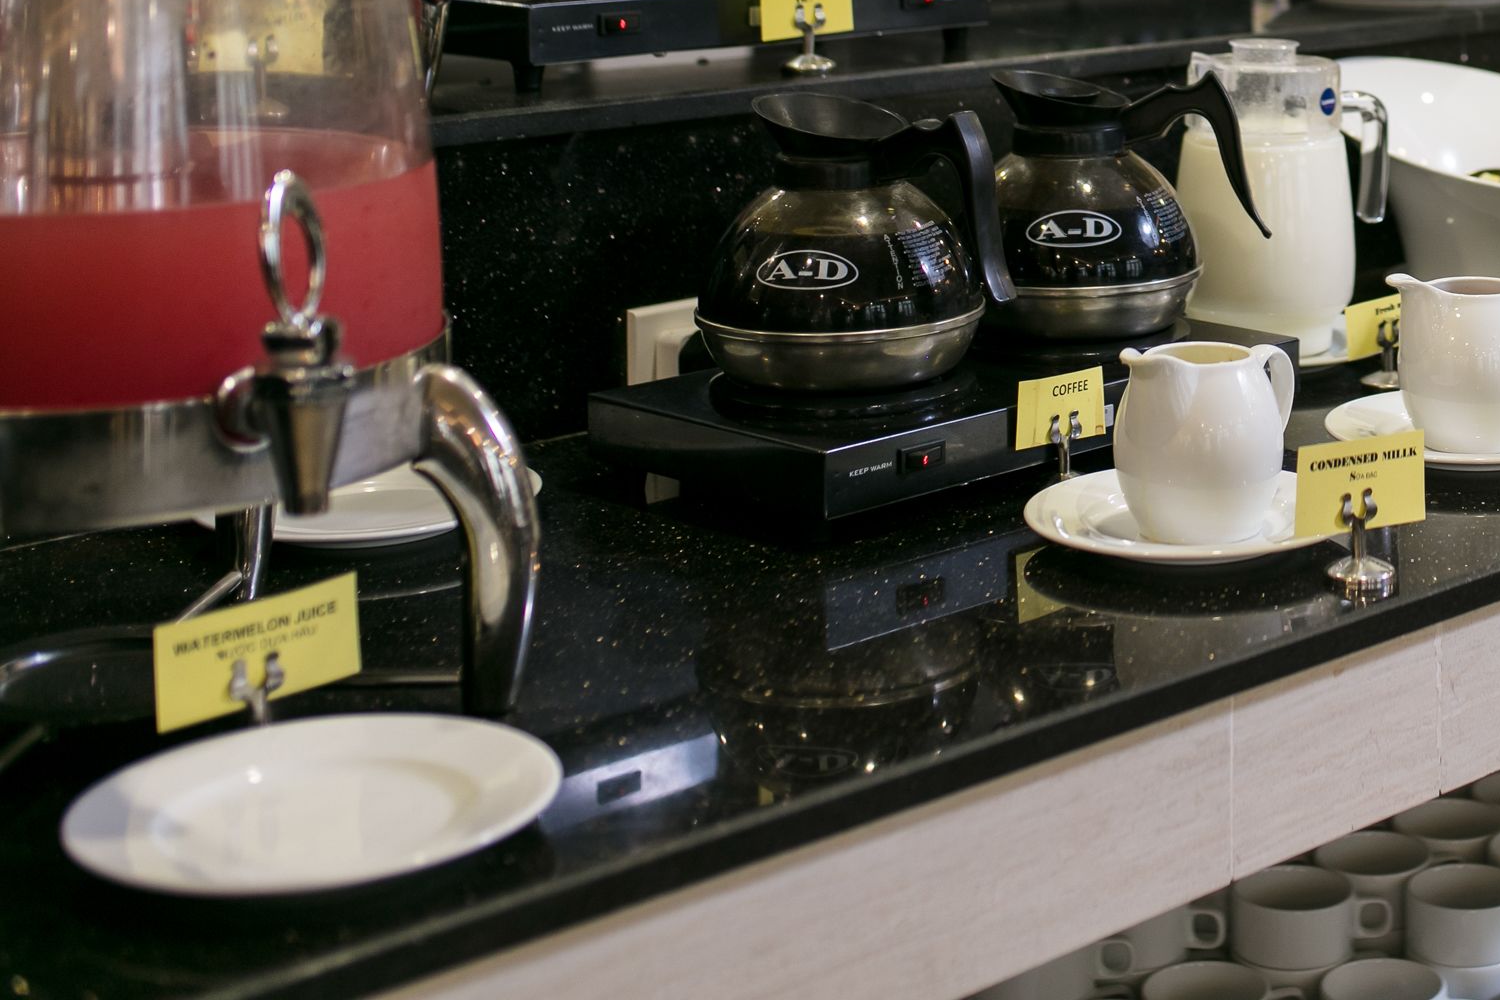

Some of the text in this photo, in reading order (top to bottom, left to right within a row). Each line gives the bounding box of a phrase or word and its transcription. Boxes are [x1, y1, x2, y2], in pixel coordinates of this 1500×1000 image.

[1035, 217, 1113, 241] A-D
[765, 258, 848, 281] A-D
[1052, 379, 1088, 397] COFFEE
[848, 461, 893, 478] KEEP WARM
[1310, 447, 1417, 472] CONDENSED MILLK
[172, 600, 338, 656] WATERMELON JUICE
